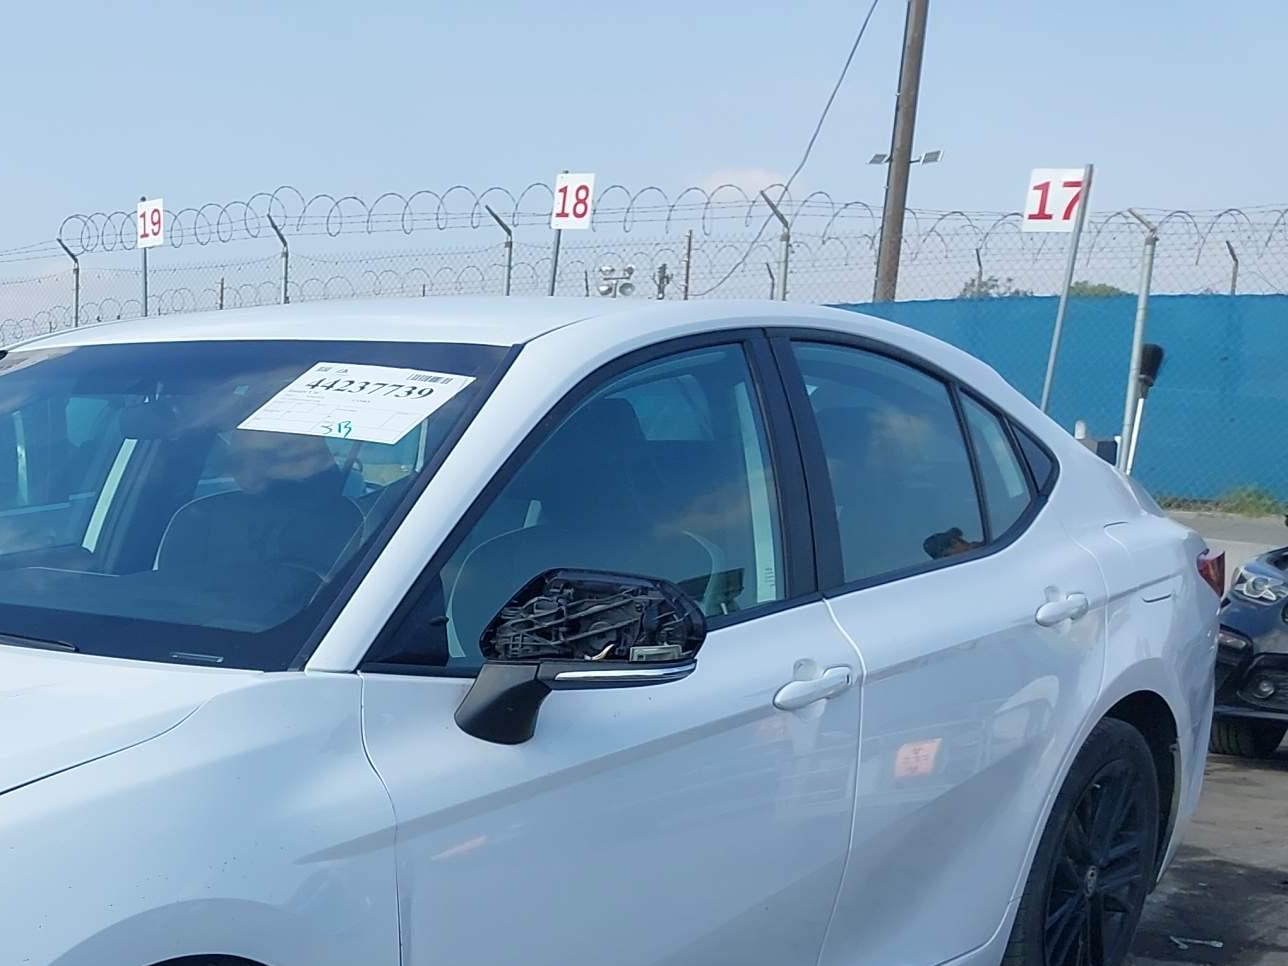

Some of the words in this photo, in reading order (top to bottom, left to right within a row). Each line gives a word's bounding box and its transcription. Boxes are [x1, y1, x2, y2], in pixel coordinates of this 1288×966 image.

[555, 185, 589, 218] 18
[1027, 181, 1083, 220] 17
[139, 208, 162, 239] 19
[305, 377, 434, 400] 44237739
